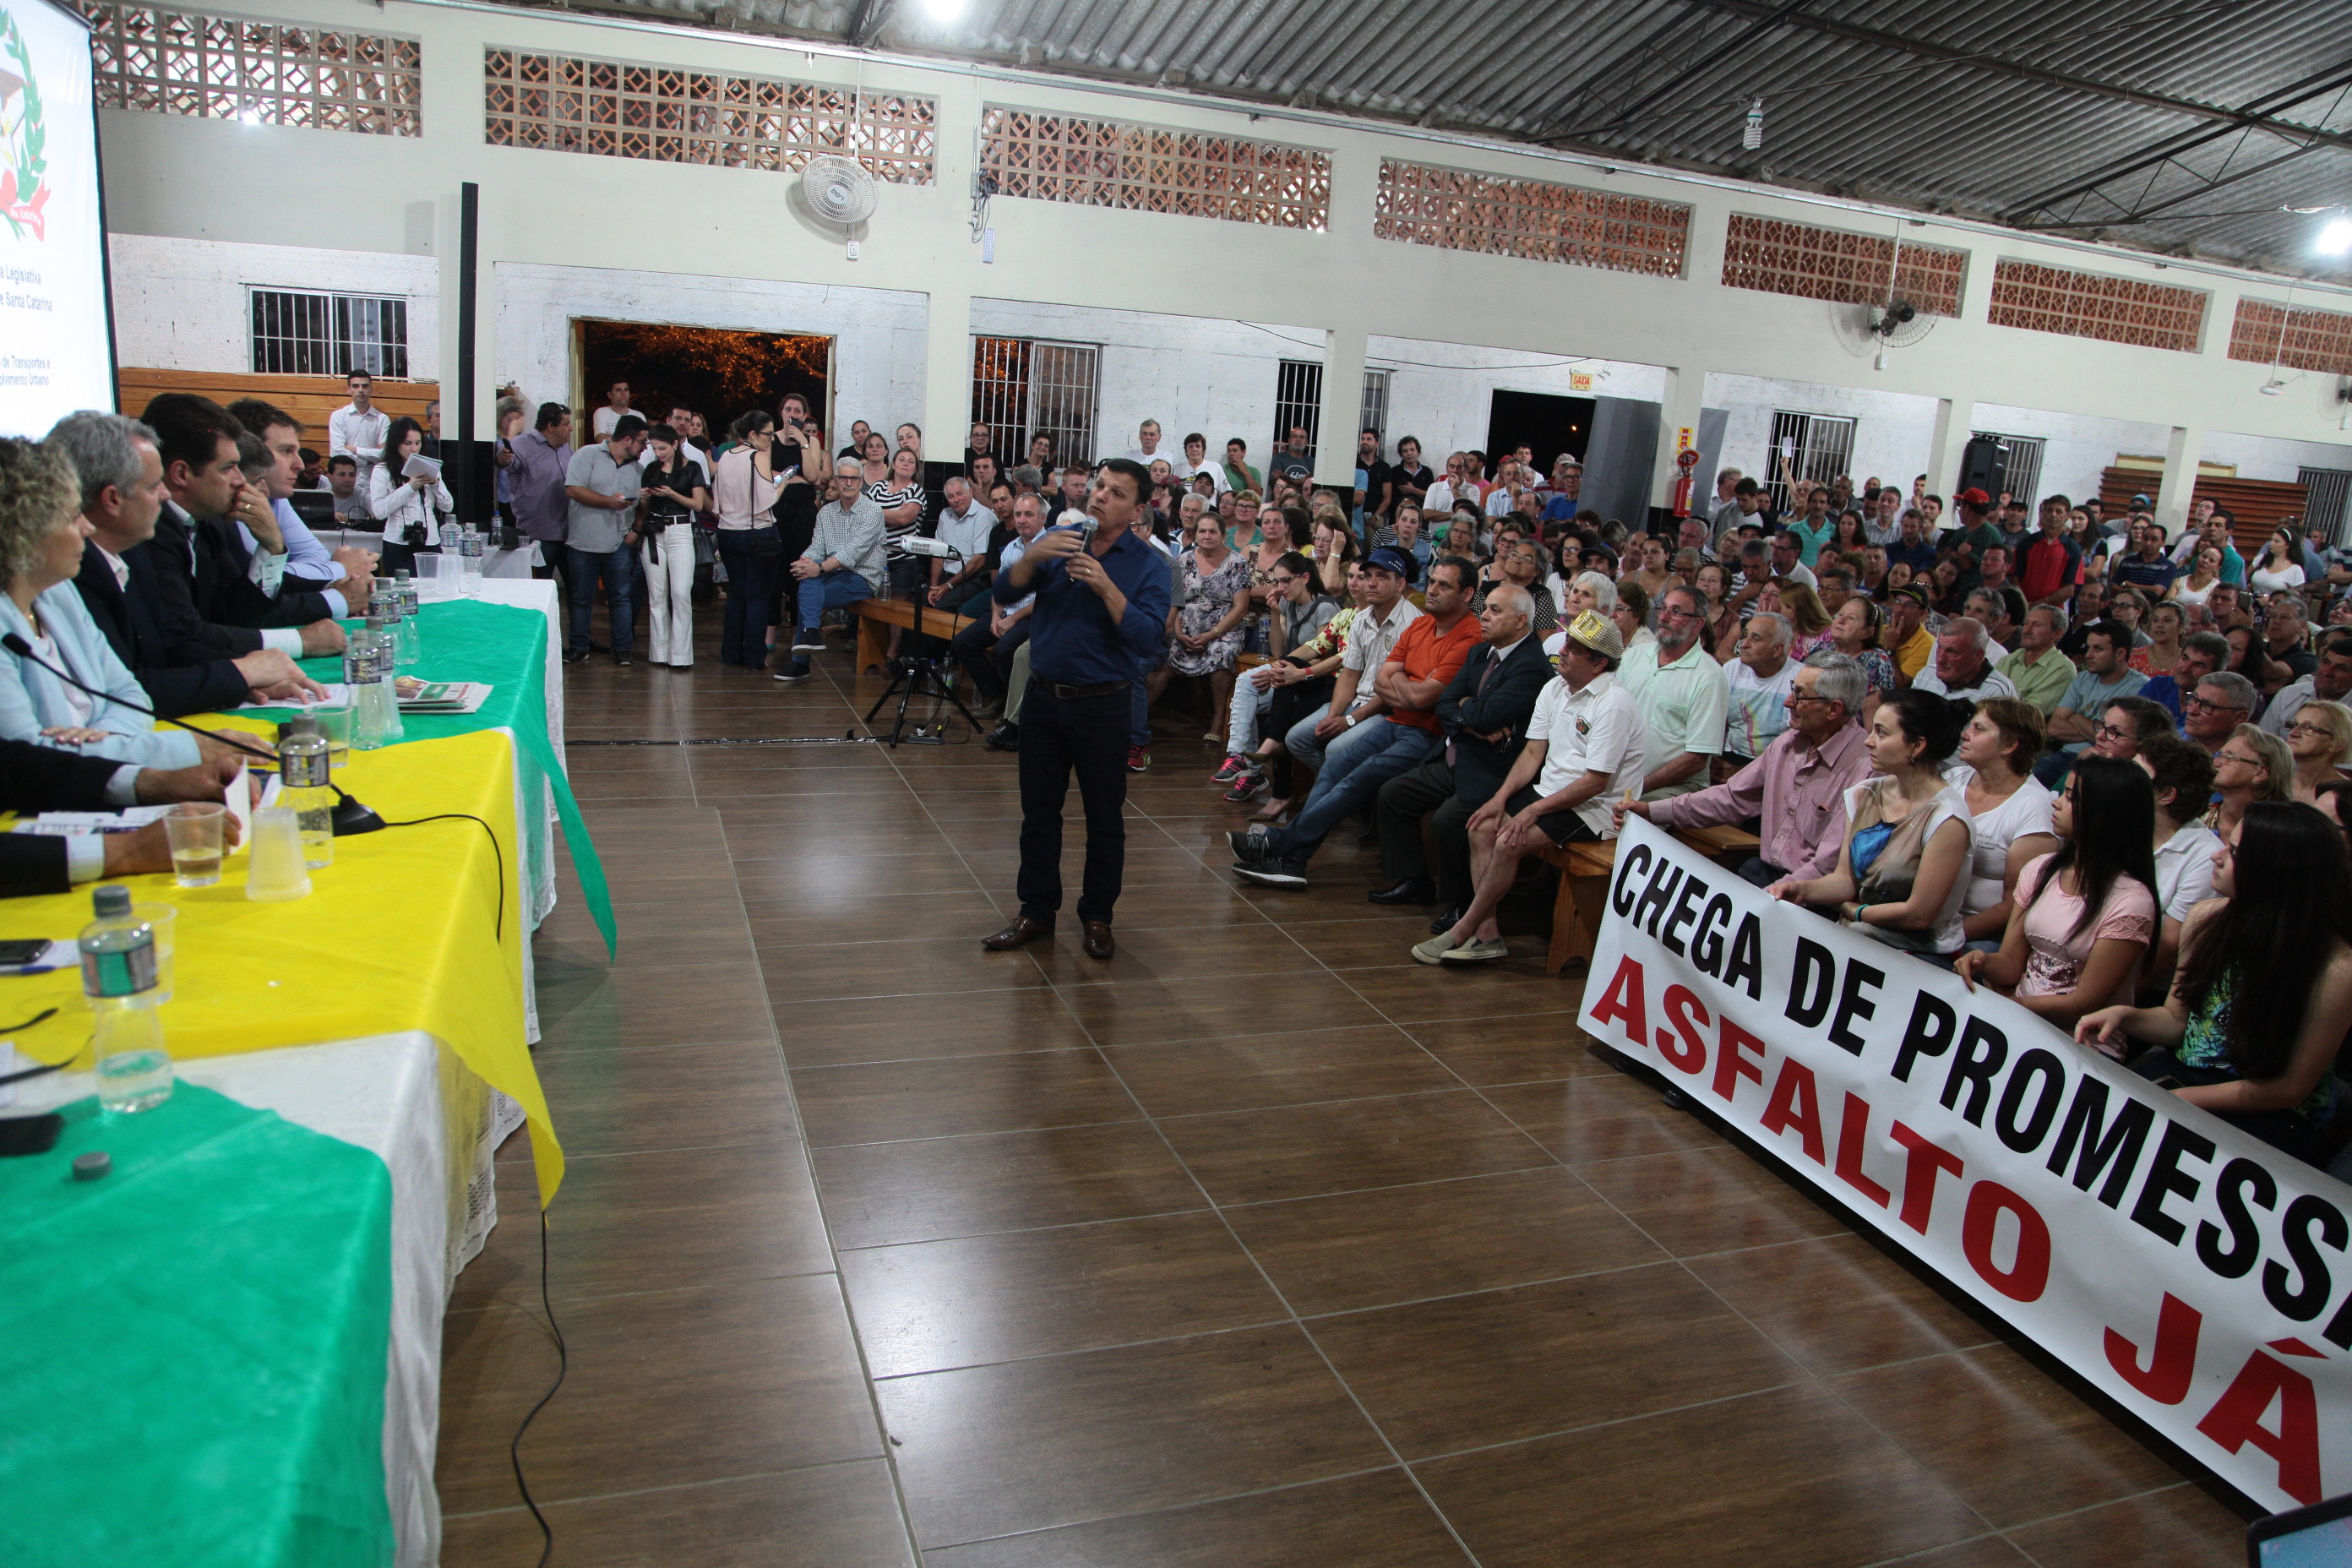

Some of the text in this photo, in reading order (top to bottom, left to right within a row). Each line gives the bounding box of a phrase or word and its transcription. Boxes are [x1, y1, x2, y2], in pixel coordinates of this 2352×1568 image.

[6, 264, 41, 286] Legislativa
[6, 291, 25, 308] Santa
[26, 294, 52, 312] Catarina
[3, 354, 10, 368] de
[11, 355, 46, 372] Transportes
[29, 373, 50, 386] Urbano
[1612, 843, 1763, 1003] CHEGA
[1784, 935, 1886, 1058] DE
[1590, 954, 2332, 1506] ASFALTO JÁ
